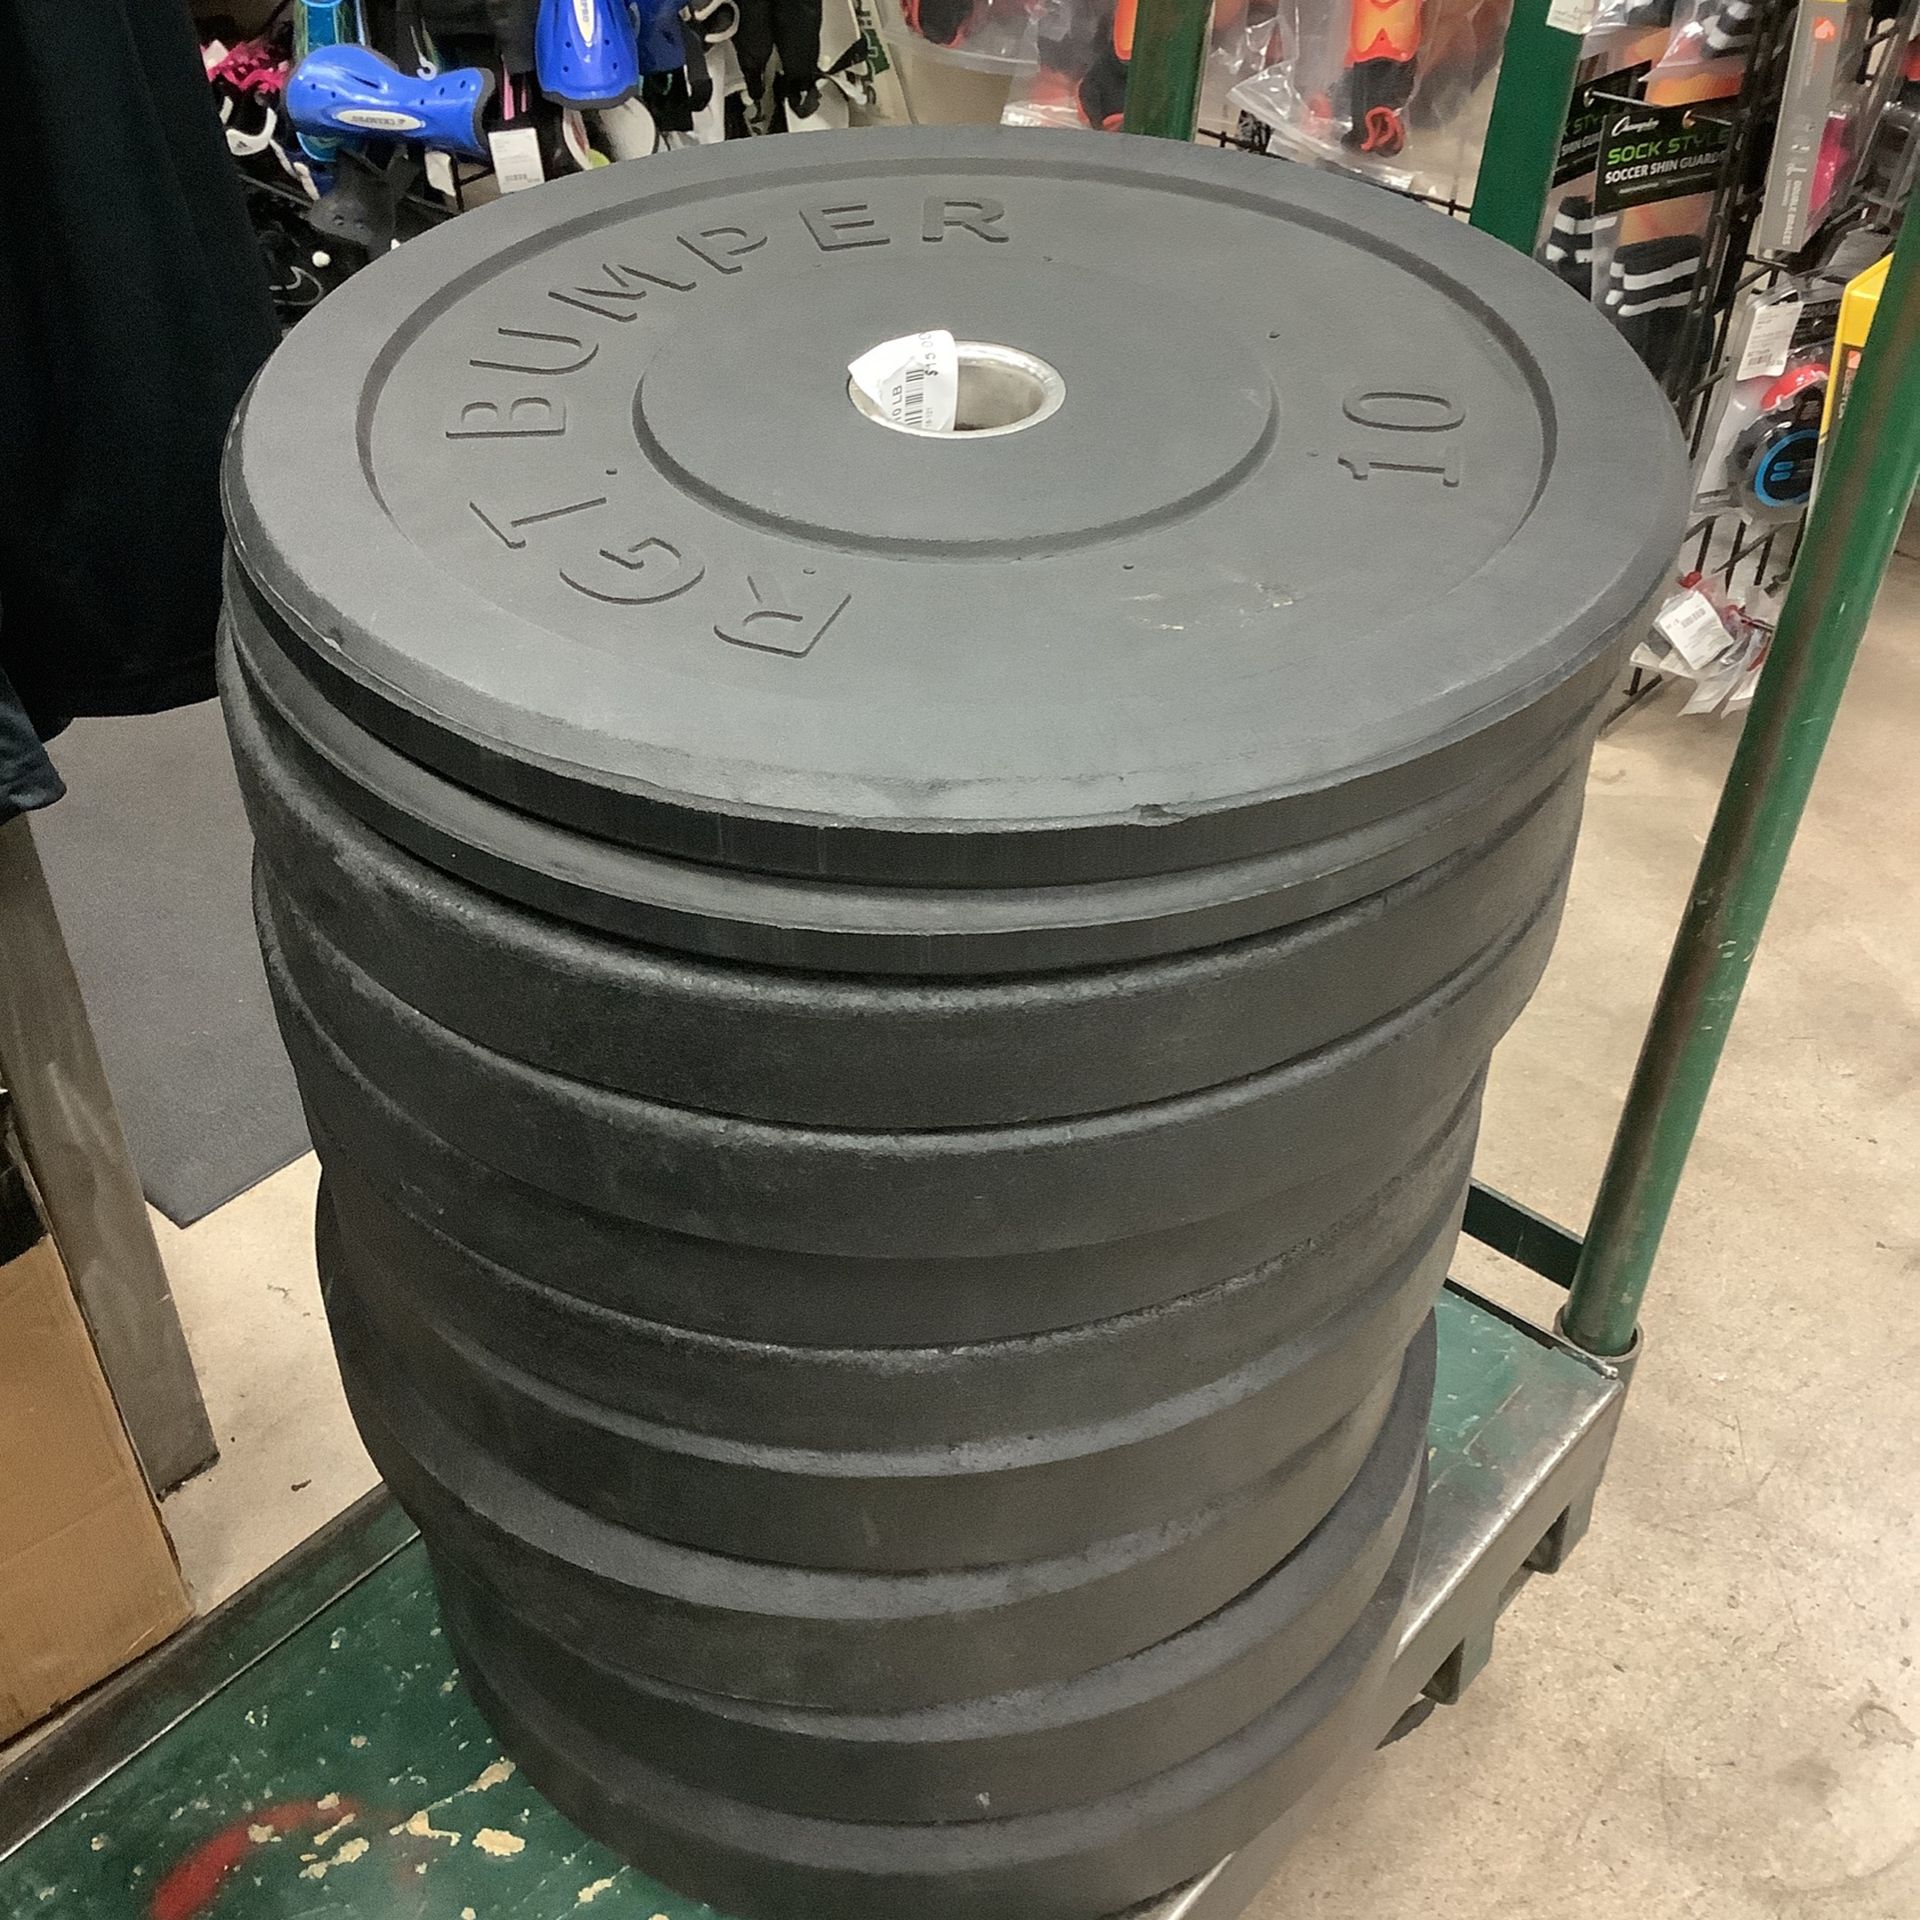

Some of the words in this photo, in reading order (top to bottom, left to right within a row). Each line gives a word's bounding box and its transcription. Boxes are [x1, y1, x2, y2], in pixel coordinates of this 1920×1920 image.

[1606, 140, 1664, 166] SOCK
[1604, 163, 1649, 186] SOCCER
[1650, 158, 1679, 176] SHIN
[446, 200, 1010, 437] BUMPER
[892, 385, 903, 406] LB
[1338, 387, 1466, 488] 10
